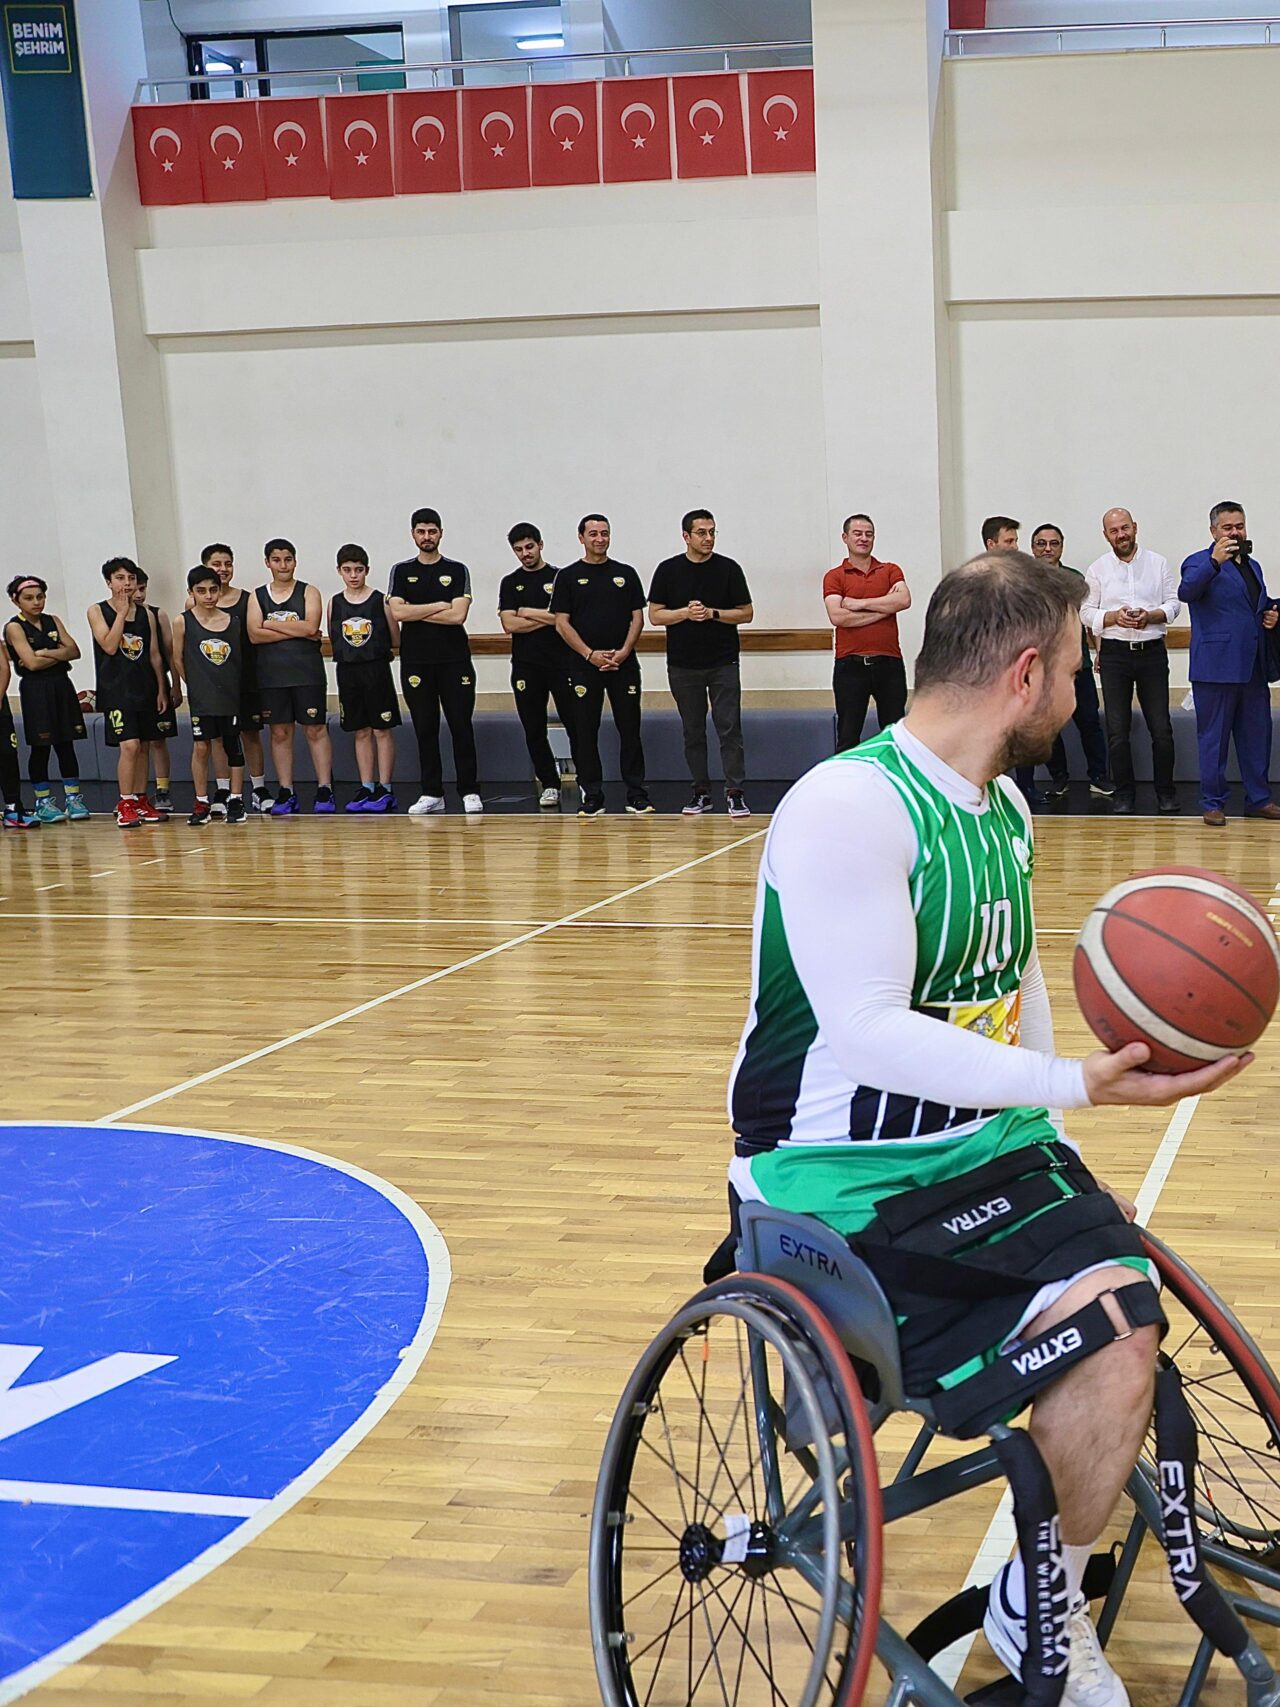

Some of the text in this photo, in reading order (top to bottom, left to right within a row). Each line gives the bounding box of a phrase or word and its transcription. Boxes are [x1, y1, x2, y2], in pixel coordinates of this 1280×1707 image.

[109, 709, 124, 728] 12
[972, 898, 1012, 977] 10
[943, 1197, 1012, 1234] EXTRA
[779, 1234, 842, 1280] EXTRA
[1012, 1327, 1083, 1375] EXTRA
[1037, 1520, 1050, 1551] THE
[1159, 1460, 1202, 1602] EXTRA
